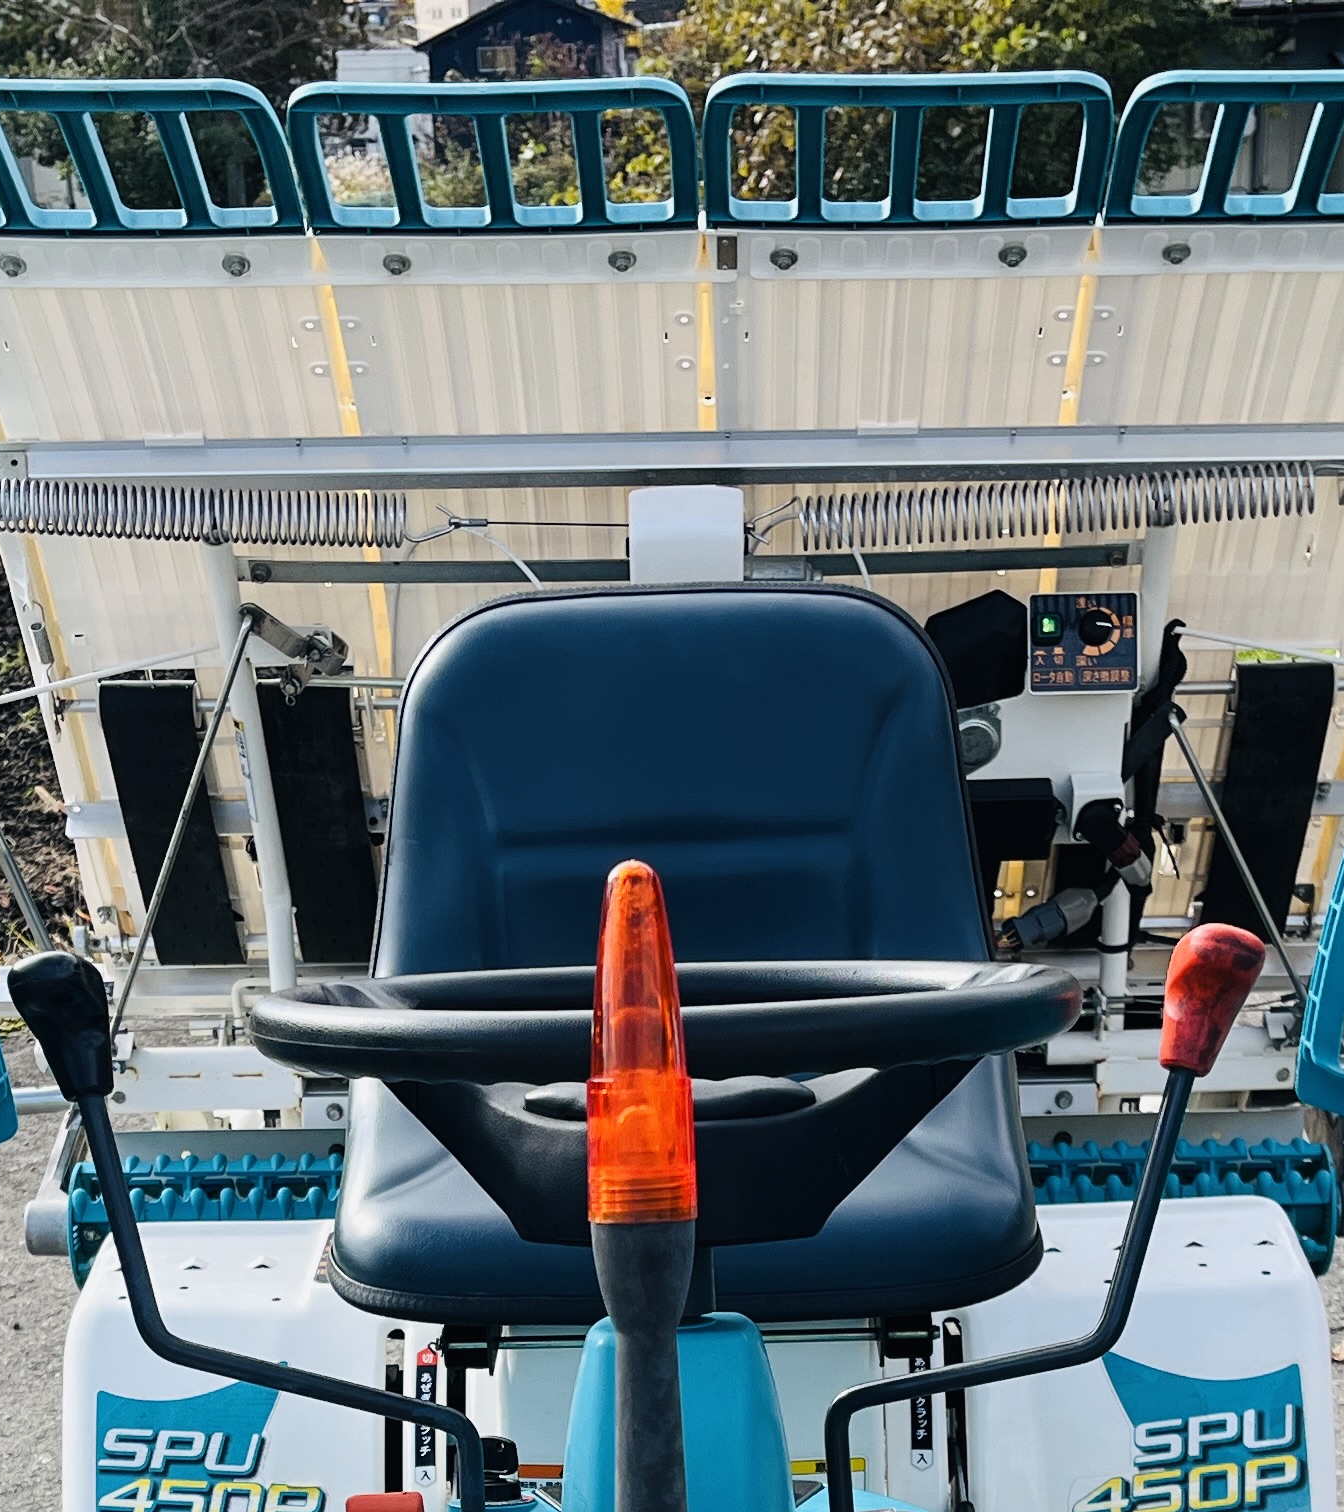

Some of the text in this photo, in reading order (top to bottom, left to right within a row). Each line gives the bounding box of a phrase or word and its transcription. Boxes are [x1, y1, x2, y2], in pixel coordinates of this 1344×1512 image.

[1134, 1403, 1296, 1467] SPU
[98, 1428, 263, 1475] SPU
[916, 1453, 928, 1465] 入
[420, 1470, 432, 1481] 入
